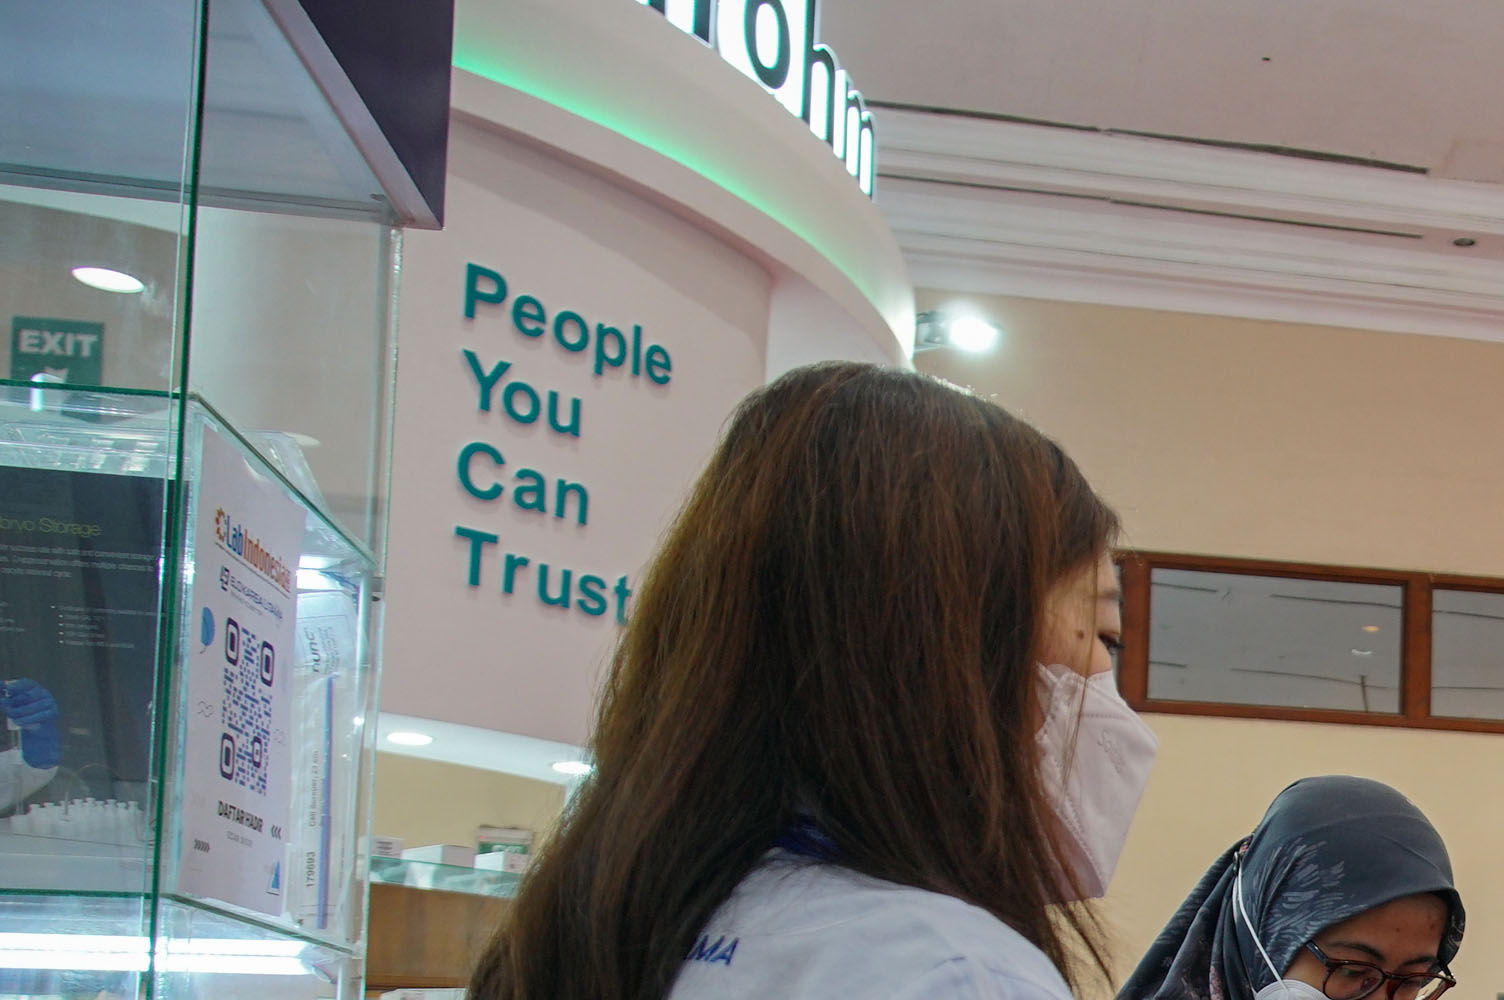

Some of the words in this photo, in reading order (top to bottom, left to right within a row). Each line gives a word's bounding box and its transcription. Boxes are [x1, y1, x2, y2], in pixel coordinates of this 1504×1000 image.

[18, 328, 98, 358] EXIT
[463, 261, 673, 386] People
[462, 348, 582, 438] You
[457, 441, 590, 526] Can
[455, 525, 632, 627] Trust
